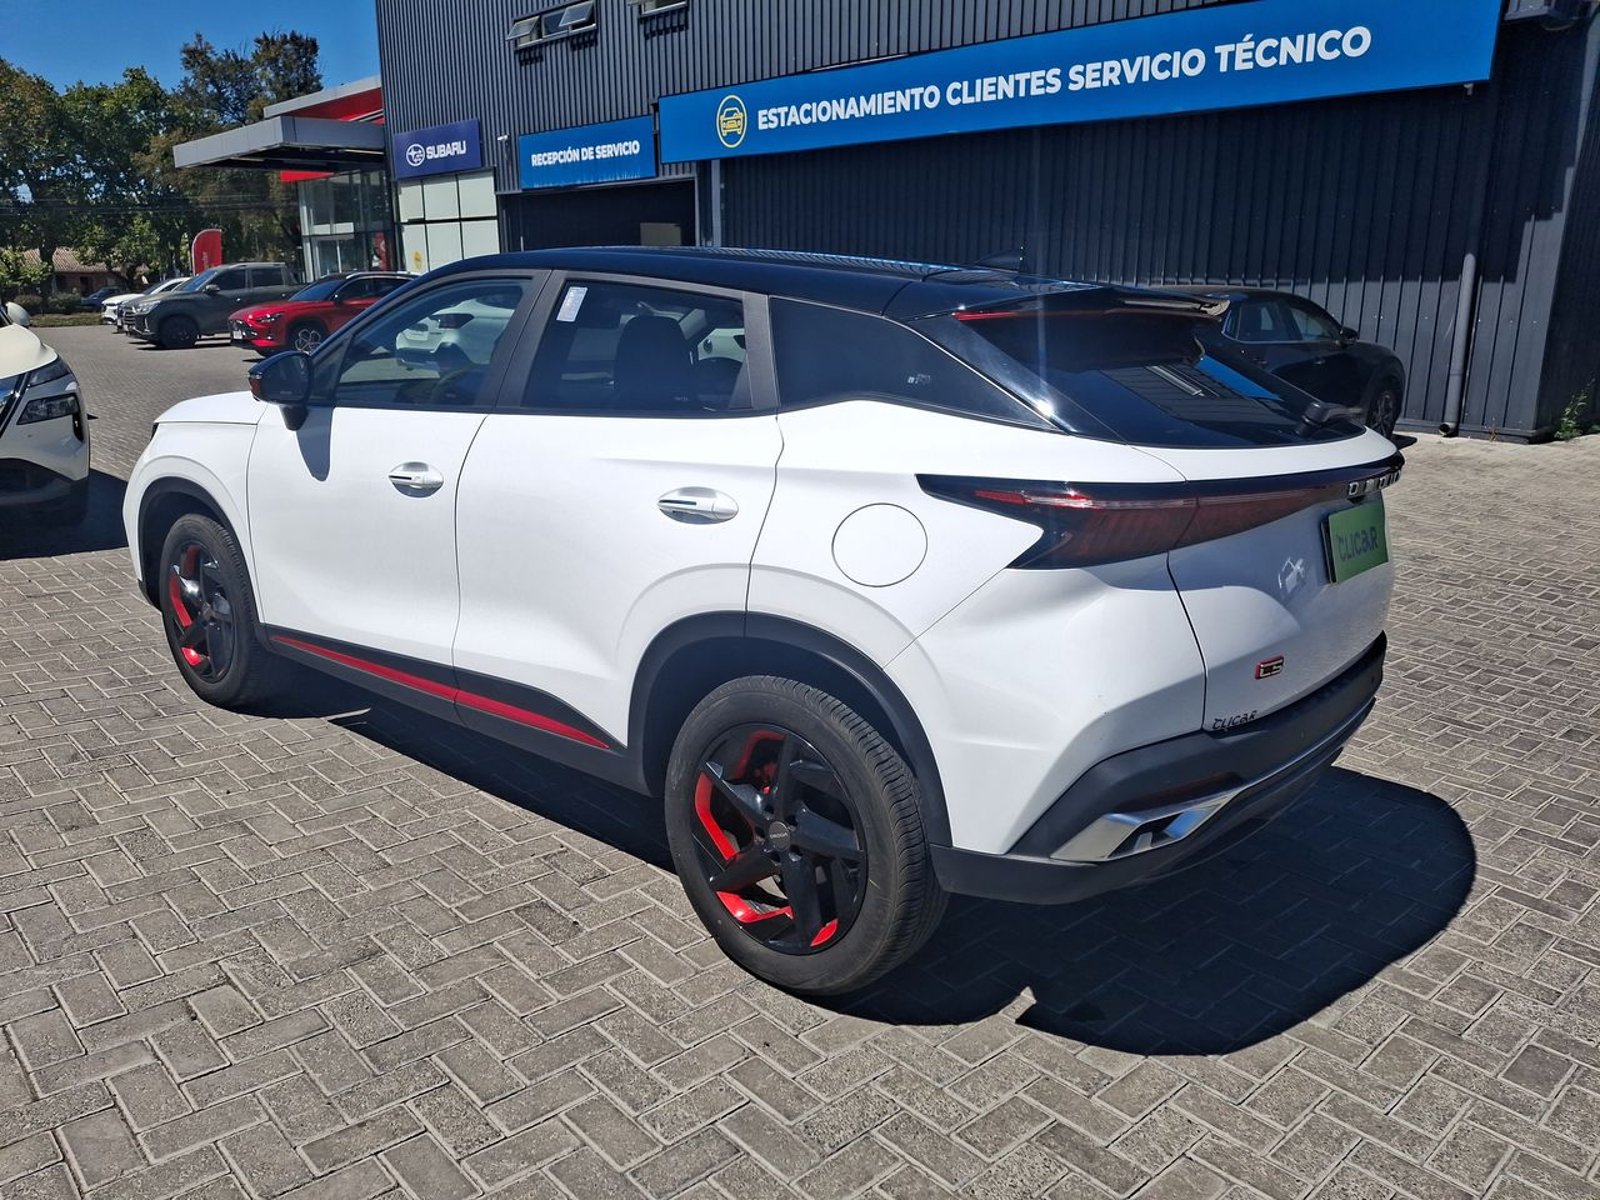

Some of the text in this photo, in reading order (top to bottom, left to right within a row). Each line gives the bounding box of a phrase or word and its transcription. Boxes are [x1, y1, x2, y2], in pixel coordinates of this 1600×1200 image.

[757, 26, 1372, 130] ESTACIONAMIENTO CLIENTES SERVICIO TÉCNICO
[426, 140, 466, 160] SUBARU
[531, 140, 641, 167] RECEPCIÓN DE SERVICIO
